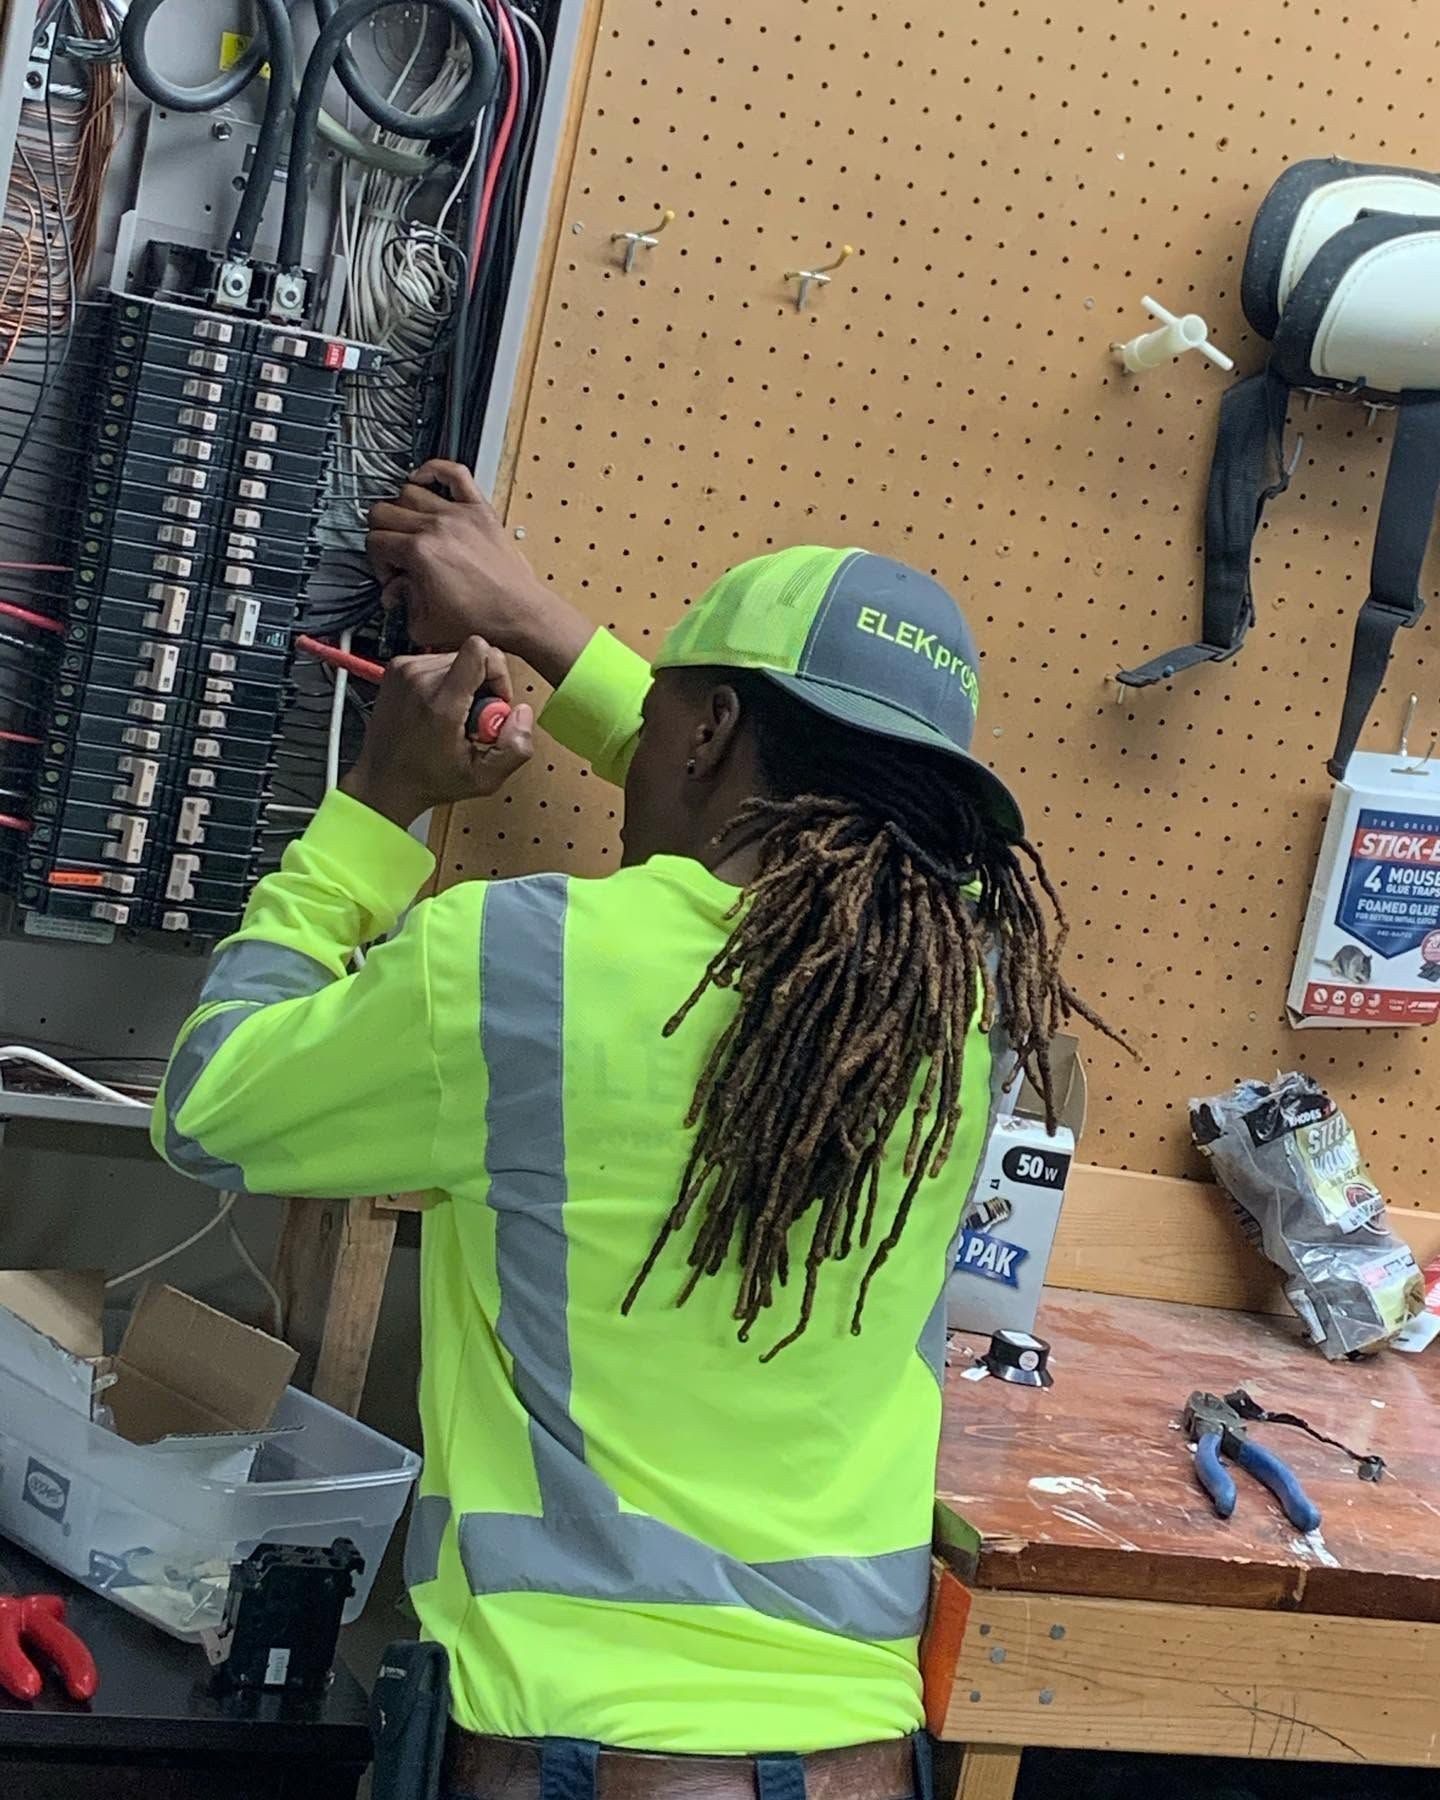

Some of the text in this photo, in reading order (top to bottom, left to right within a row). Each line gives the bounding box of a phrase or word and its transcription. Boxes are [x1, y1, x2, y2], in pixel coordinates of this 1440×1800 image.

[1364, 865, 1382, 892] 4
[1385, 884, 1410, 895] GLUE
[1357, 899, 1440, 917] FOAMED GLUE
[1307, 1112, 1349, 1155] STEEL
[963, 1236, 1018, 1278] PAK
